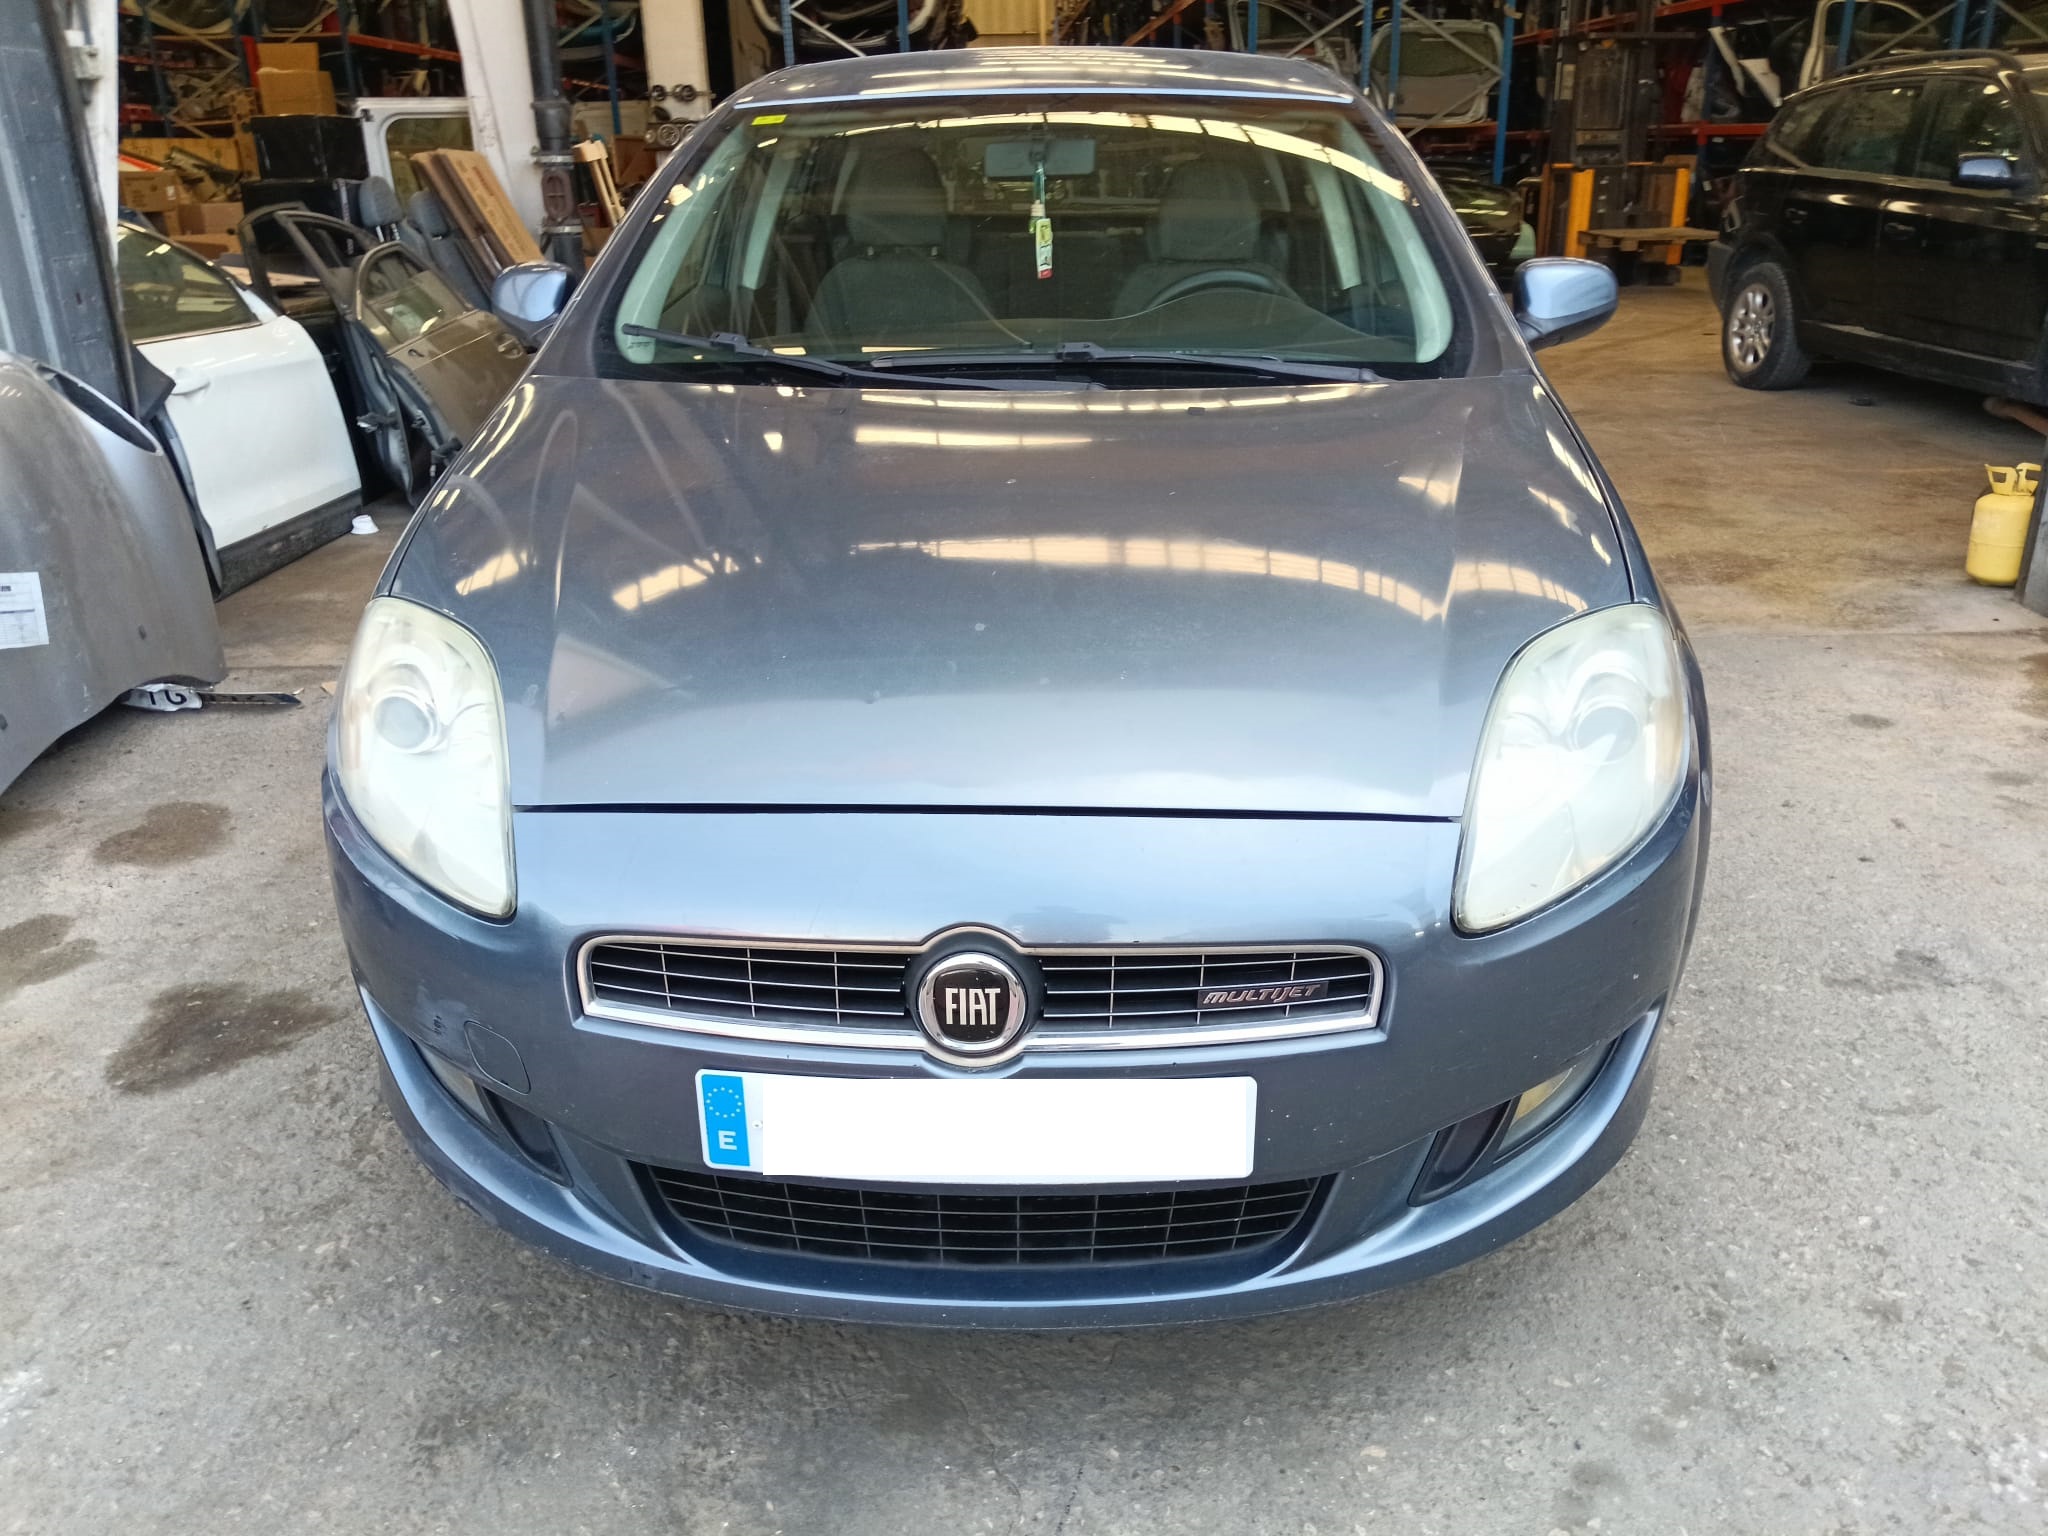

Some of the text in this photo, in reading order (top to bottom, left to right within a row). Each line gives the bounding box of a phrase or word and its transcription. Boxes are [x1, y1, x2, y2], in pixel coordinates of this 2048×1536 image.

[1202, 984, 1321, 1004] MULTIJET
[945, 987, 1001, 1026] FIAT
[718, 1130, 738, 1151] E
